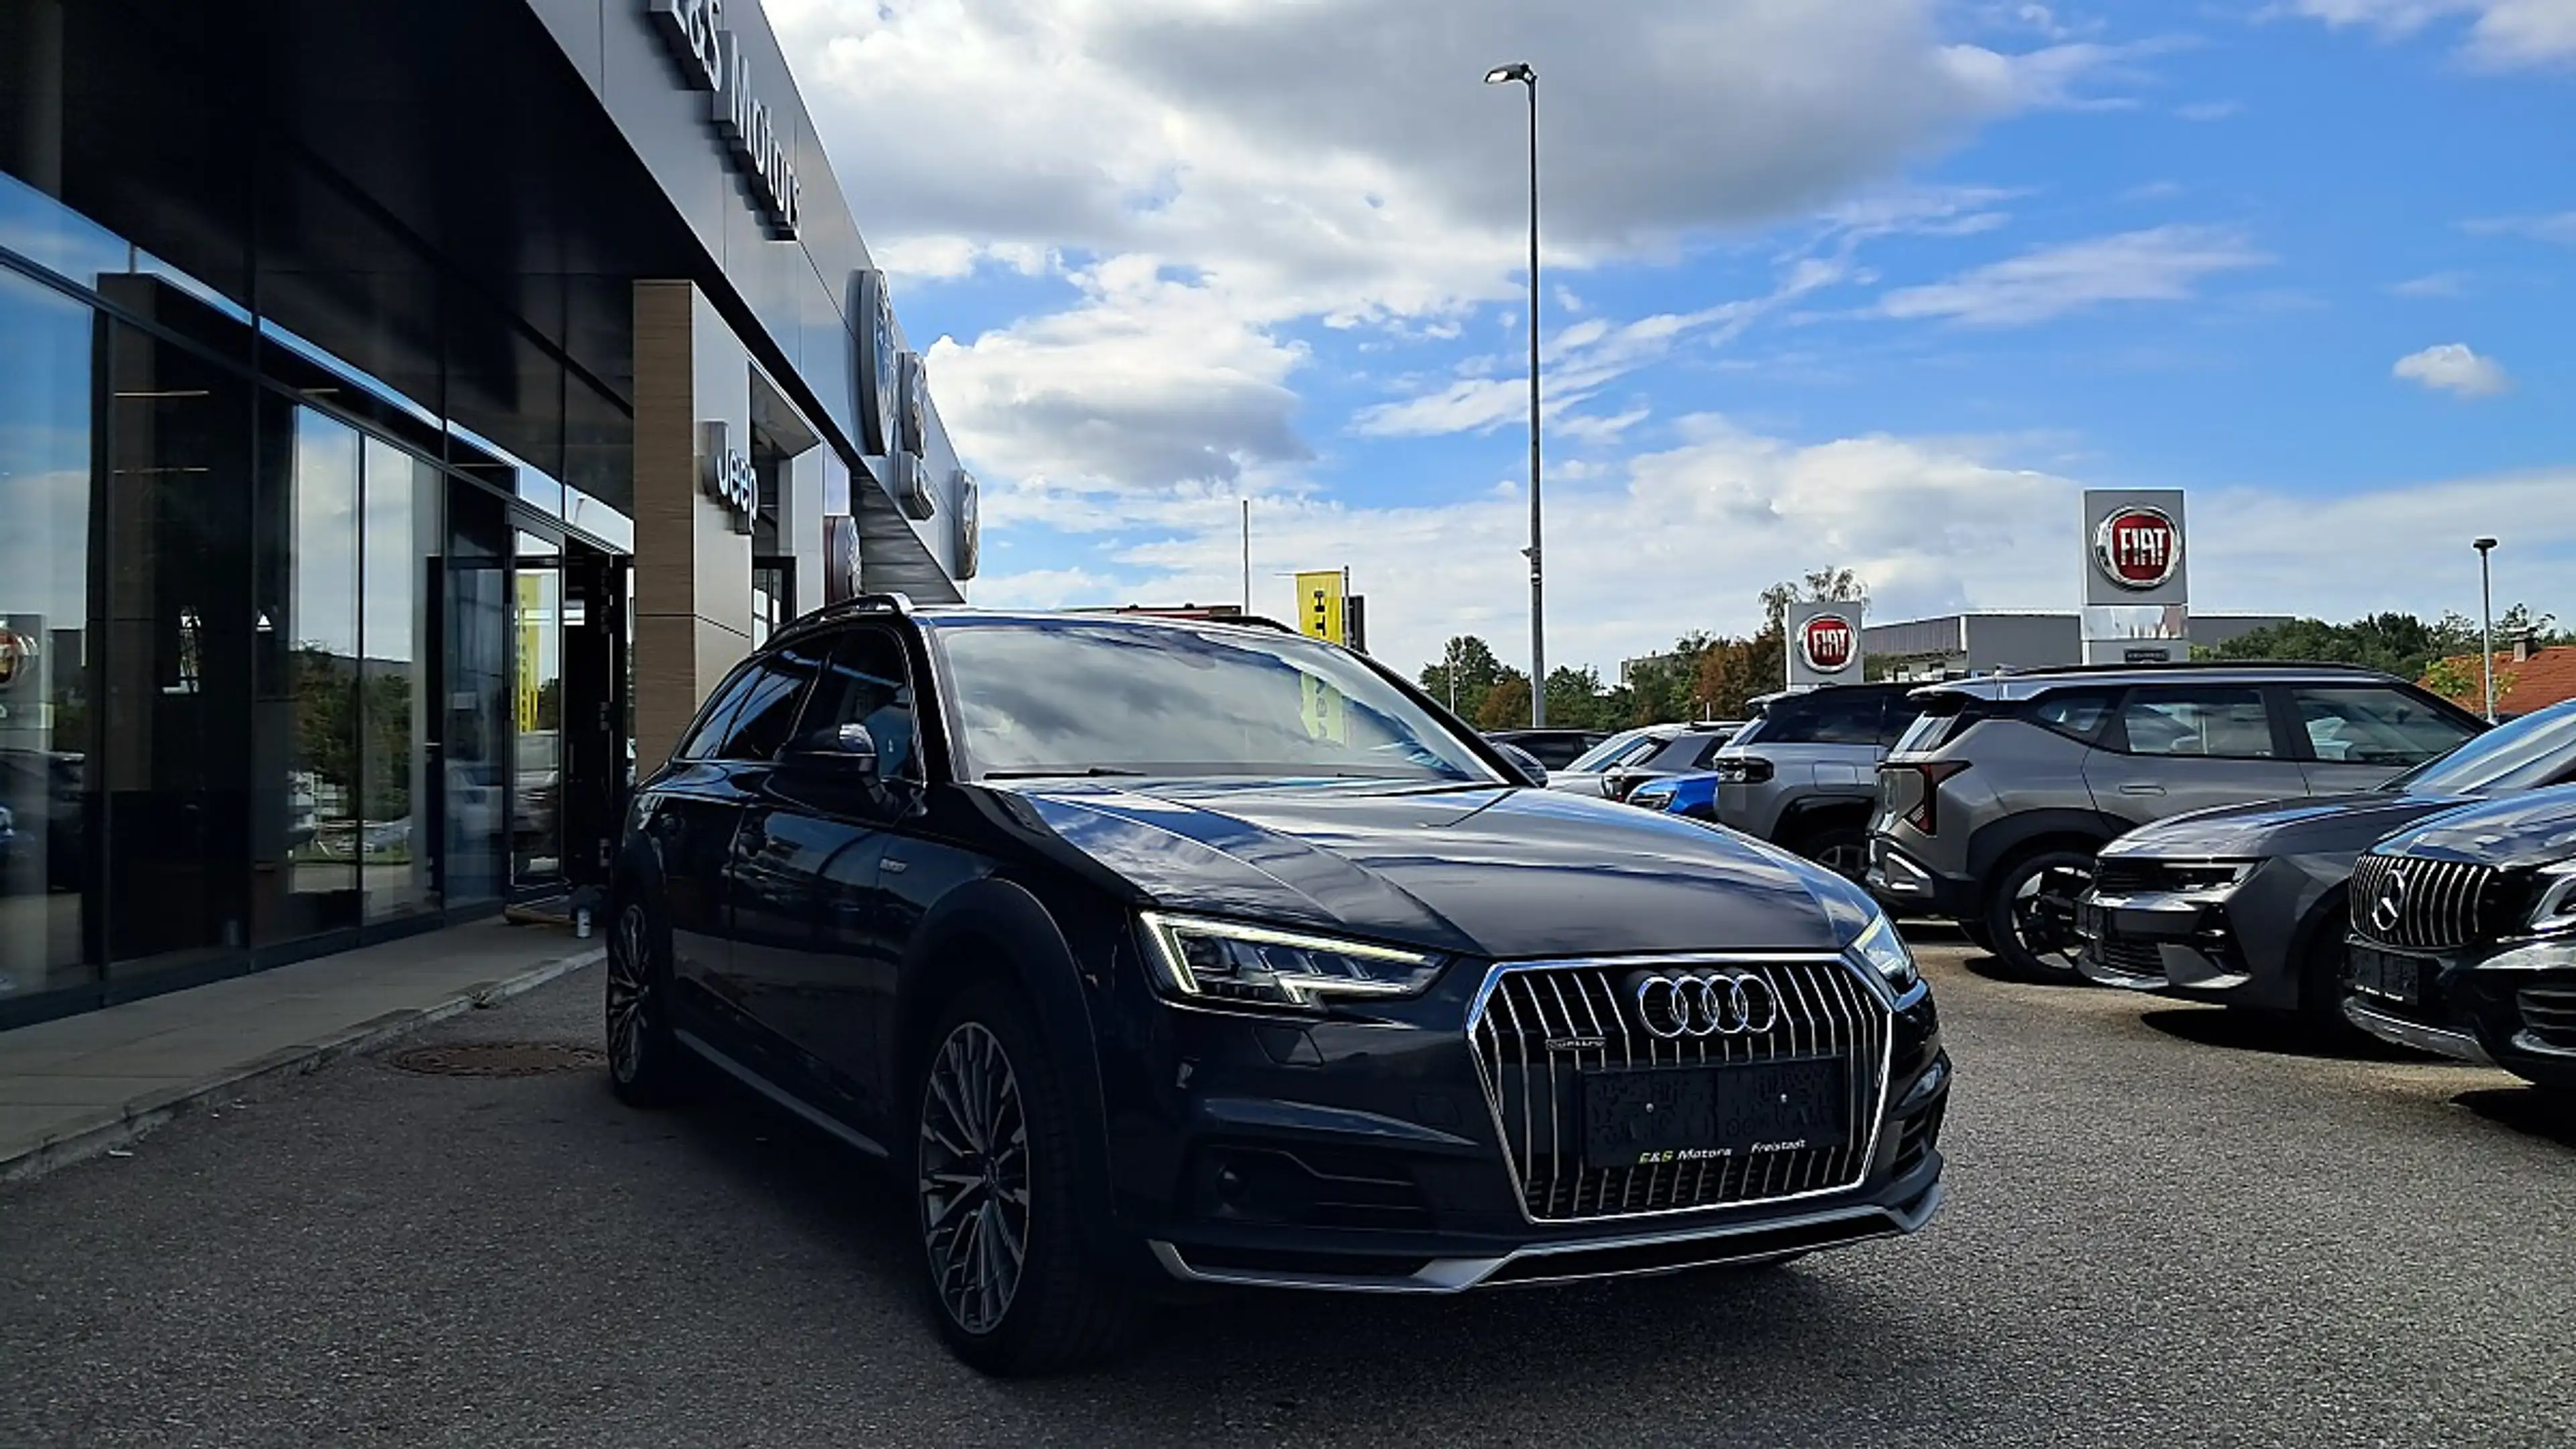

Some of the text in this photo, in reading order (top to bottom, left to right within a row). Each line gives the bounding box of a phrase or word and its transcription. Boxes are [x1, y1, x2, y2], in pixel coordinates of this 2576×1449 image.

[731, 32, 802, 241] Motors
[716, 425, 759, 535] Jeep
[2119, 528, 2167, 566] FIAT
[1812, 628, 1847, 657] FIAT
[1639, 1150, 1673, 1164] E&S
[1677, 1148, 1733, 1160] Motors
